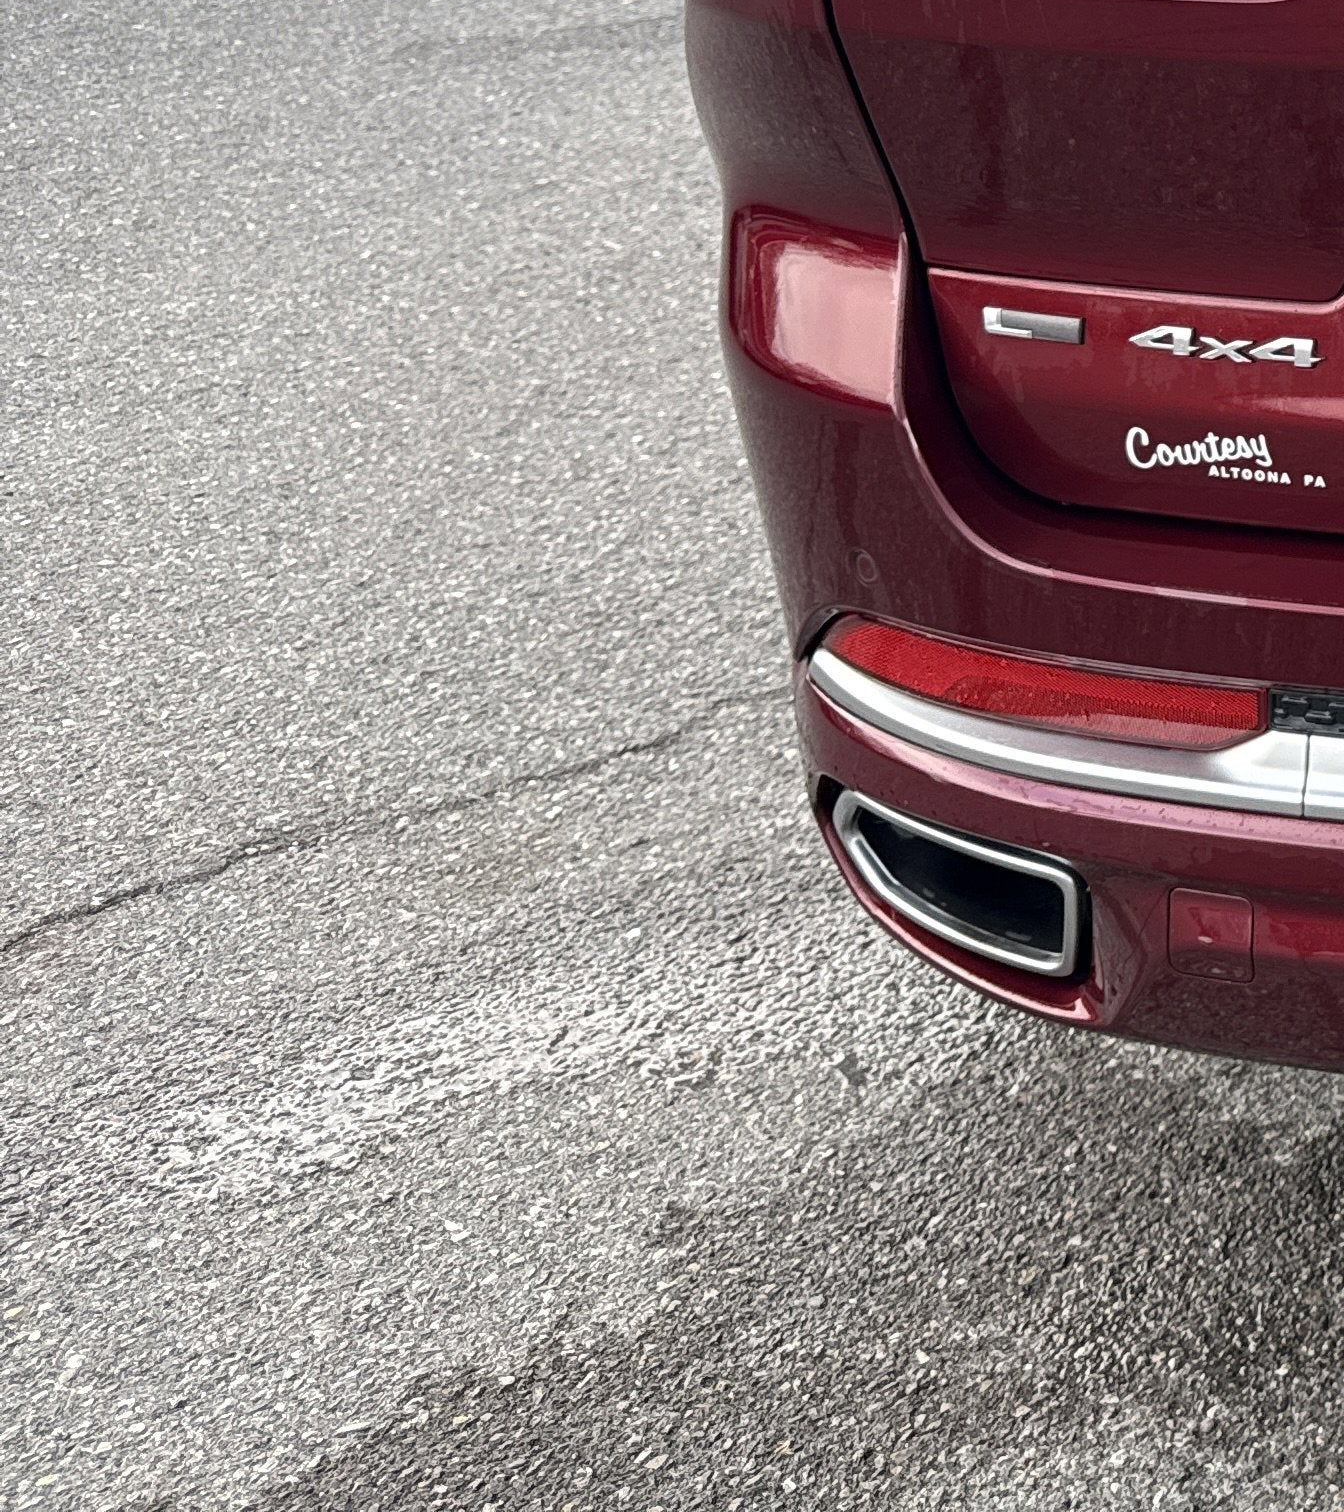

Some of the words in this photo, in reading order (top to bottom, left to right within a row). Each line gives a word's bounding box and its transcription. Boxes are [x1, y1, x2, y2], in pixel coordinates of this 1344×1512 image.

[1128, 325, 1326, 368] 4x4
[1125, 426, 1272, 468] Courtesy
[1208, 465, 1292, 485] ALTOONA
[1303, 474, 1326, 488] PA
